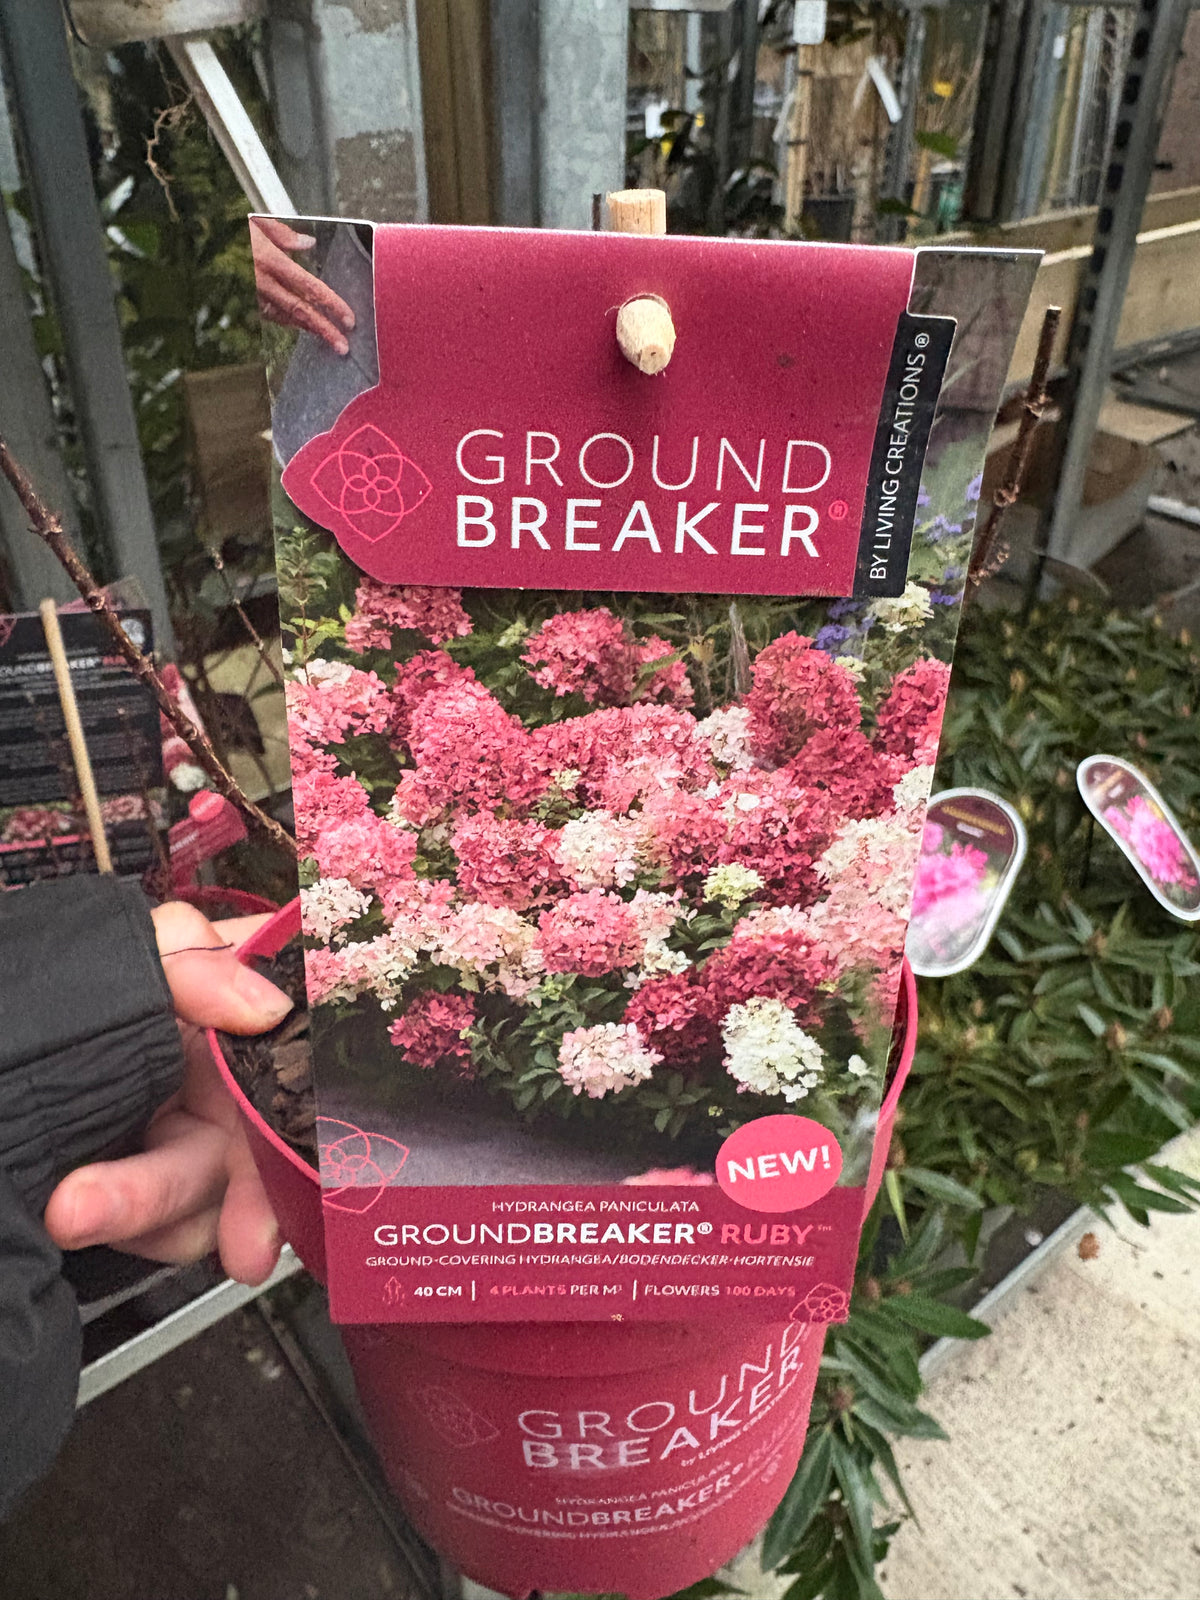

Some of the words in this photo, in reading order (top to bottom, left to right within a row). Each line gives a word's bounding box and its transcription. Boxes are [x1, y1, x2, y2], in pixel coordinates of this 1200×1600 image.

[456, 429, 832, 494] GROUND
[873, 479, 900, 549] LIVING
[869, 555, 888, 580] BY
[727, 1145, 831, 1183] NEW!
[492, 1200, 596, 1213] HYDRANGEA
[599, 1200, 700, 1213] PANICULATA
[413, 1286, 433, 1298] 40
[436, 1286, 462, 1298] CM
[502, 1284, 567, 1296] PLANTS
[570, 1284, 600, 1296] PER
[644, 1284, 720, 1297] FLOWERS
[726, 1285, 751, 1297] 100
[754, 1285, 796, 1297] DAYS
[518, 1322, 806, 1439] GROUND
